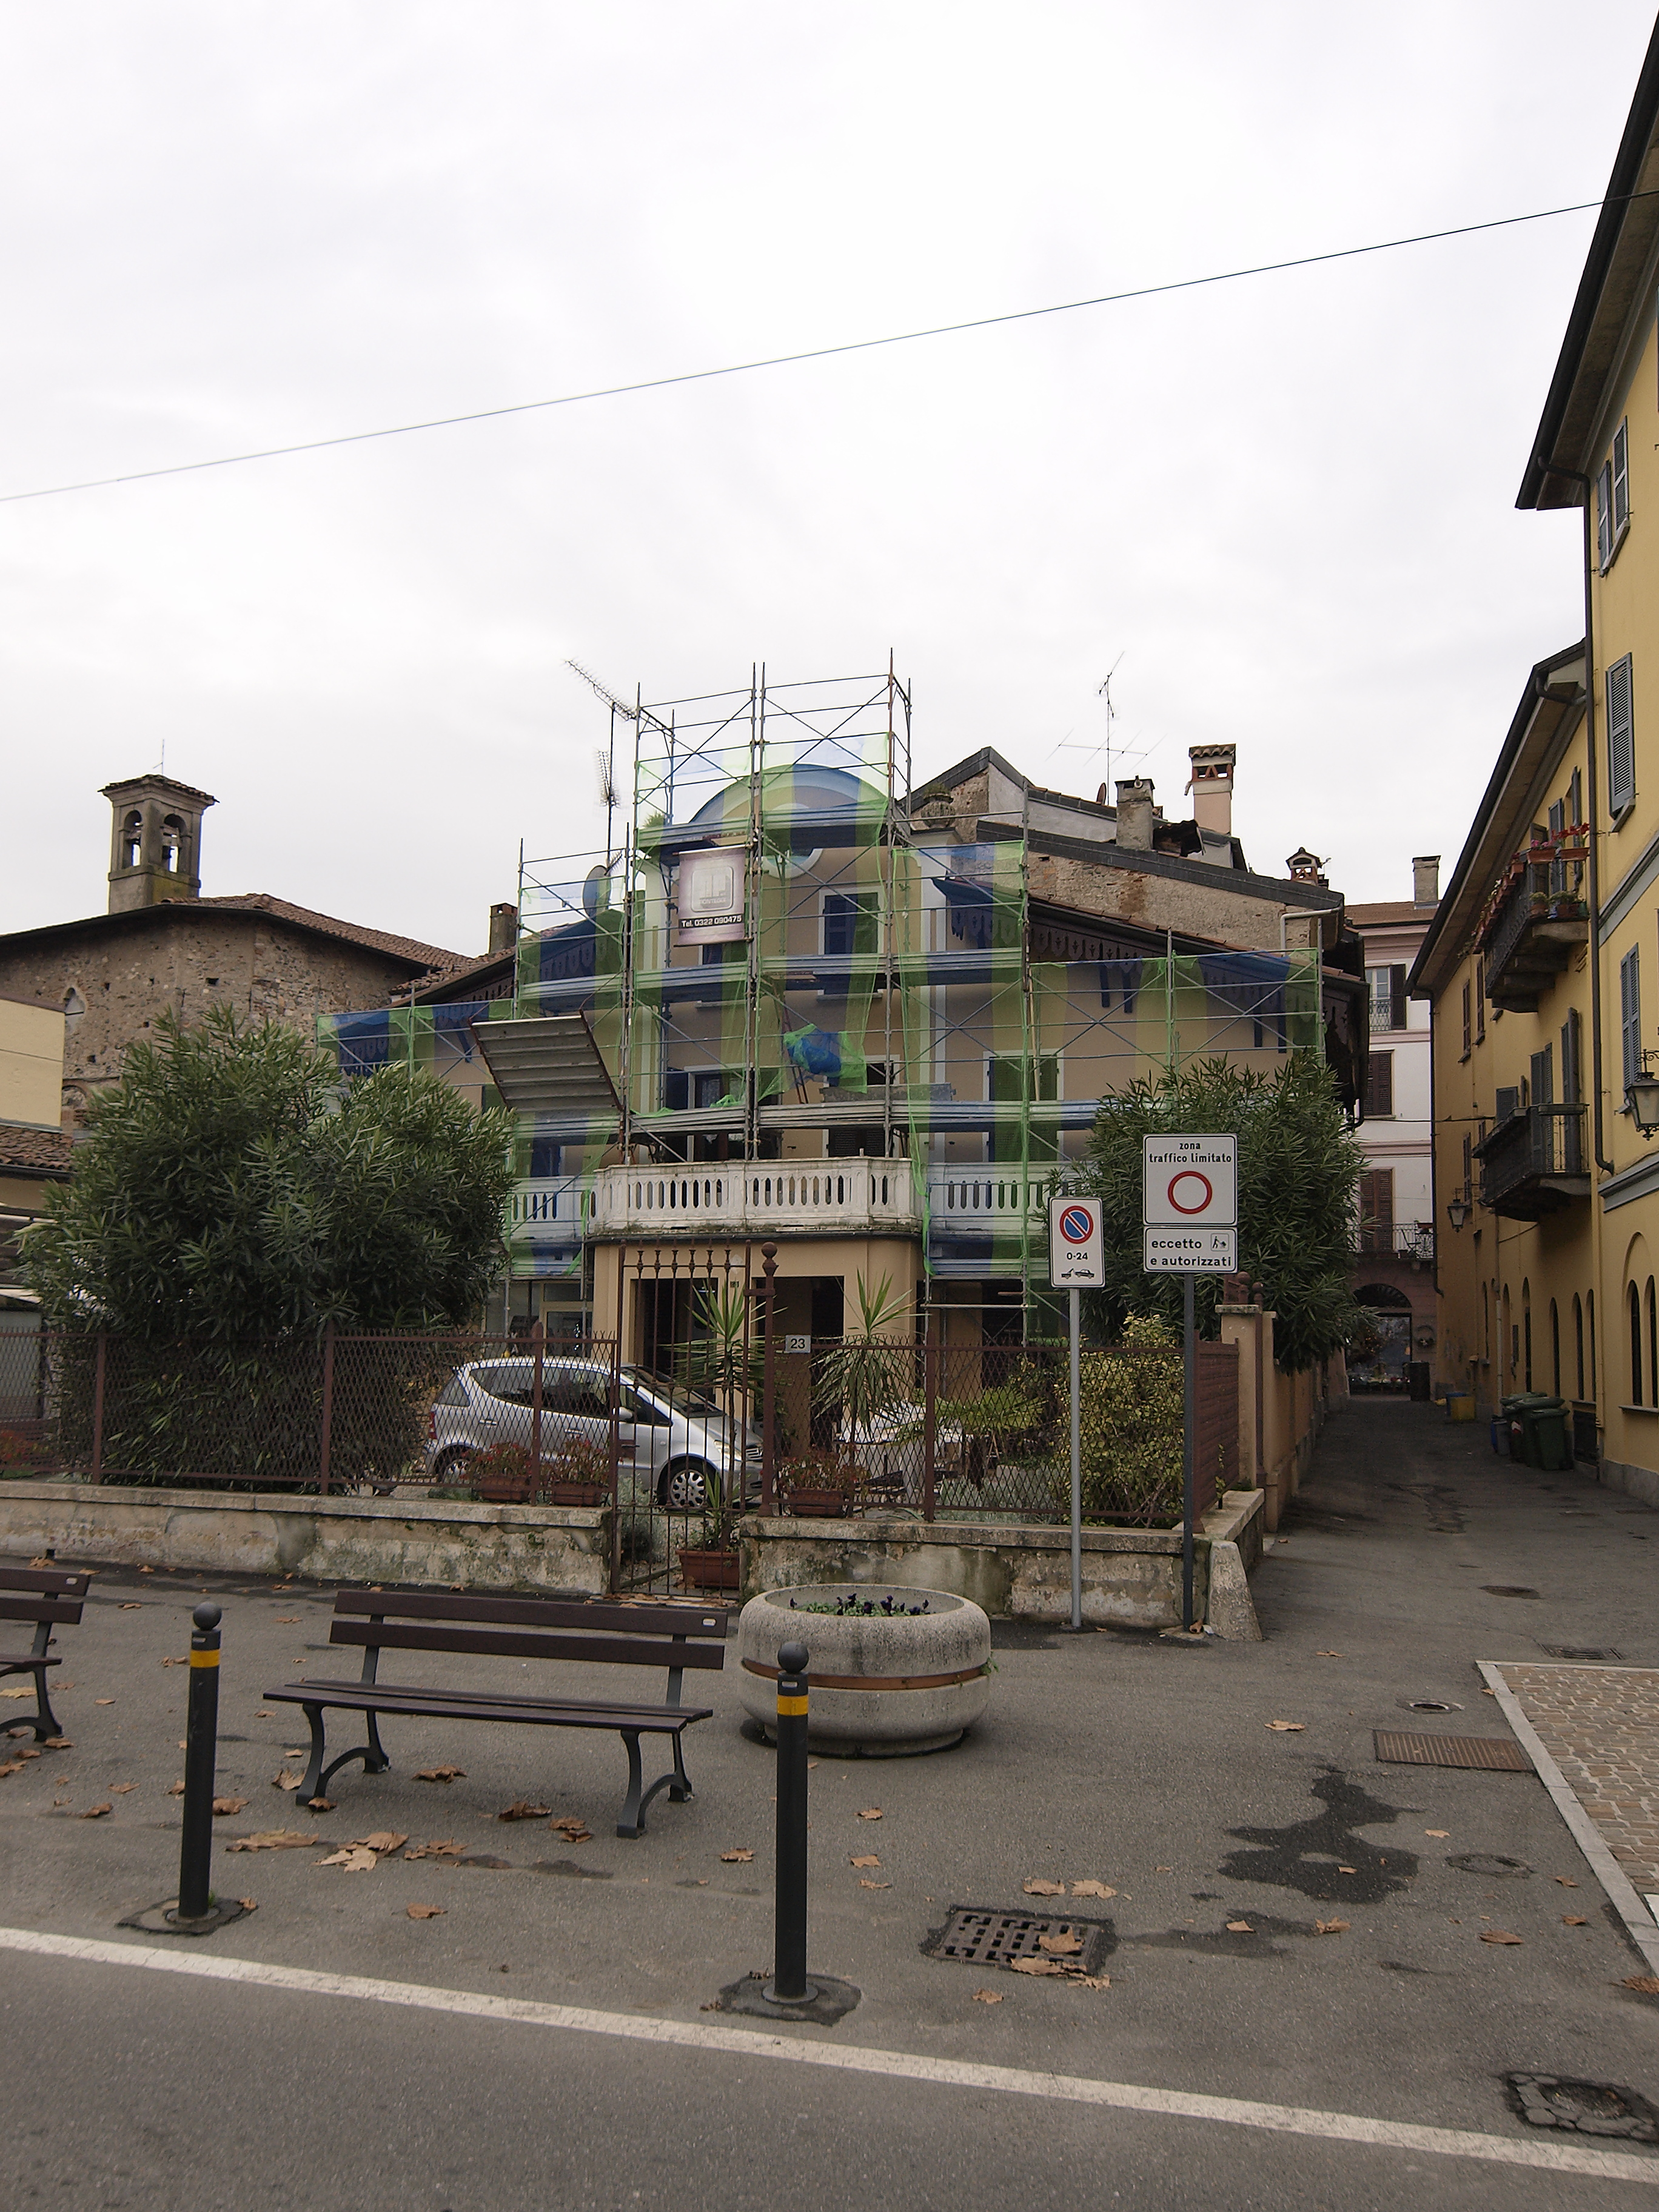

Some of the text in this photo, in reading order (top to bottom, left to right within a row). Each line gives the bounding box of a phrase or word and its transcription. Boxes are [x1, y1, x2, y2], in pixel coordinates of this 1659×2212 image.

[1149, 1153, 1232, 1163] traffico limitato
[1151, 1238, 1202, 1249] eccetto
[1161, 1256, 1231, 1267] autorizzati
[791, 1338, 805, 1349] 23
